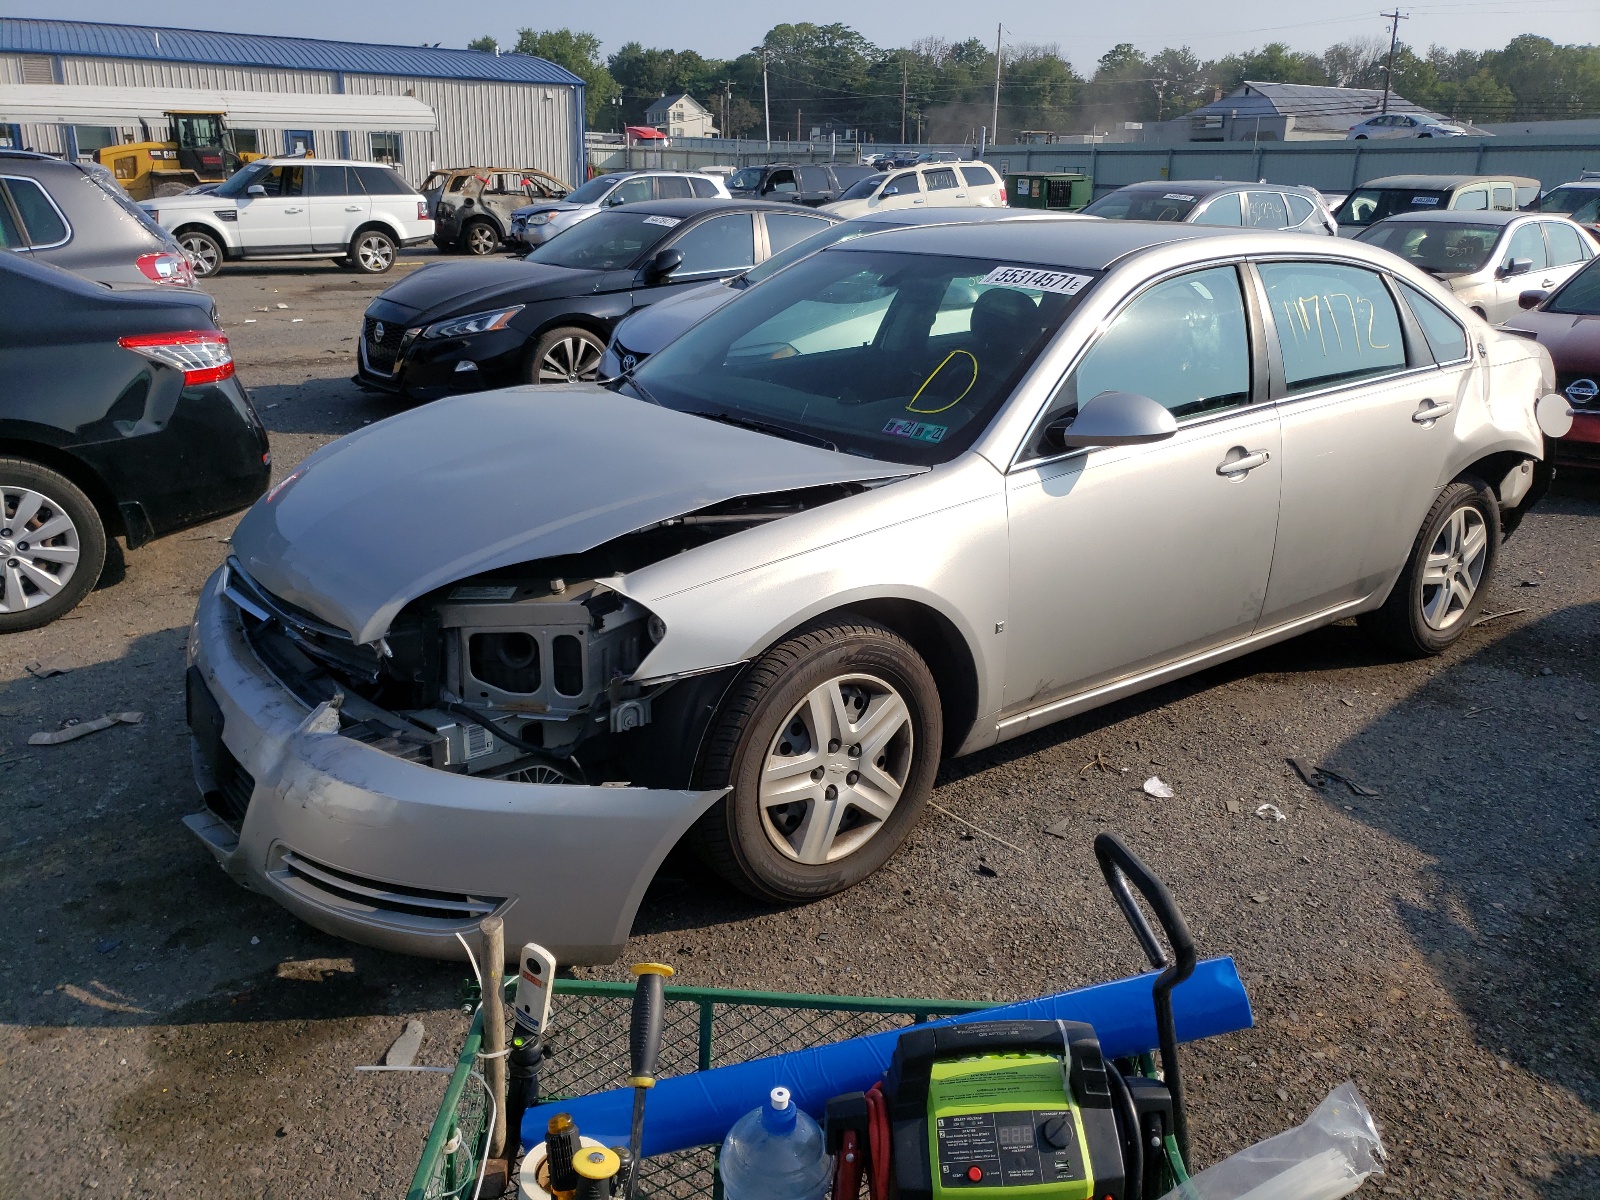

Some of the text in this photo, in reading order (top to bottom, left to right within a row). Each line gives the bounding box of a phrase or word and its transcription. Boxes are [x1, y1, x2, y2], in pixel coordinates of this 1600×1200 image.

[163, 150, 177, 159] CAT
[995, 268, 1077, 290] 55314571
[1567, 387, 1596, 395] NISSAN
